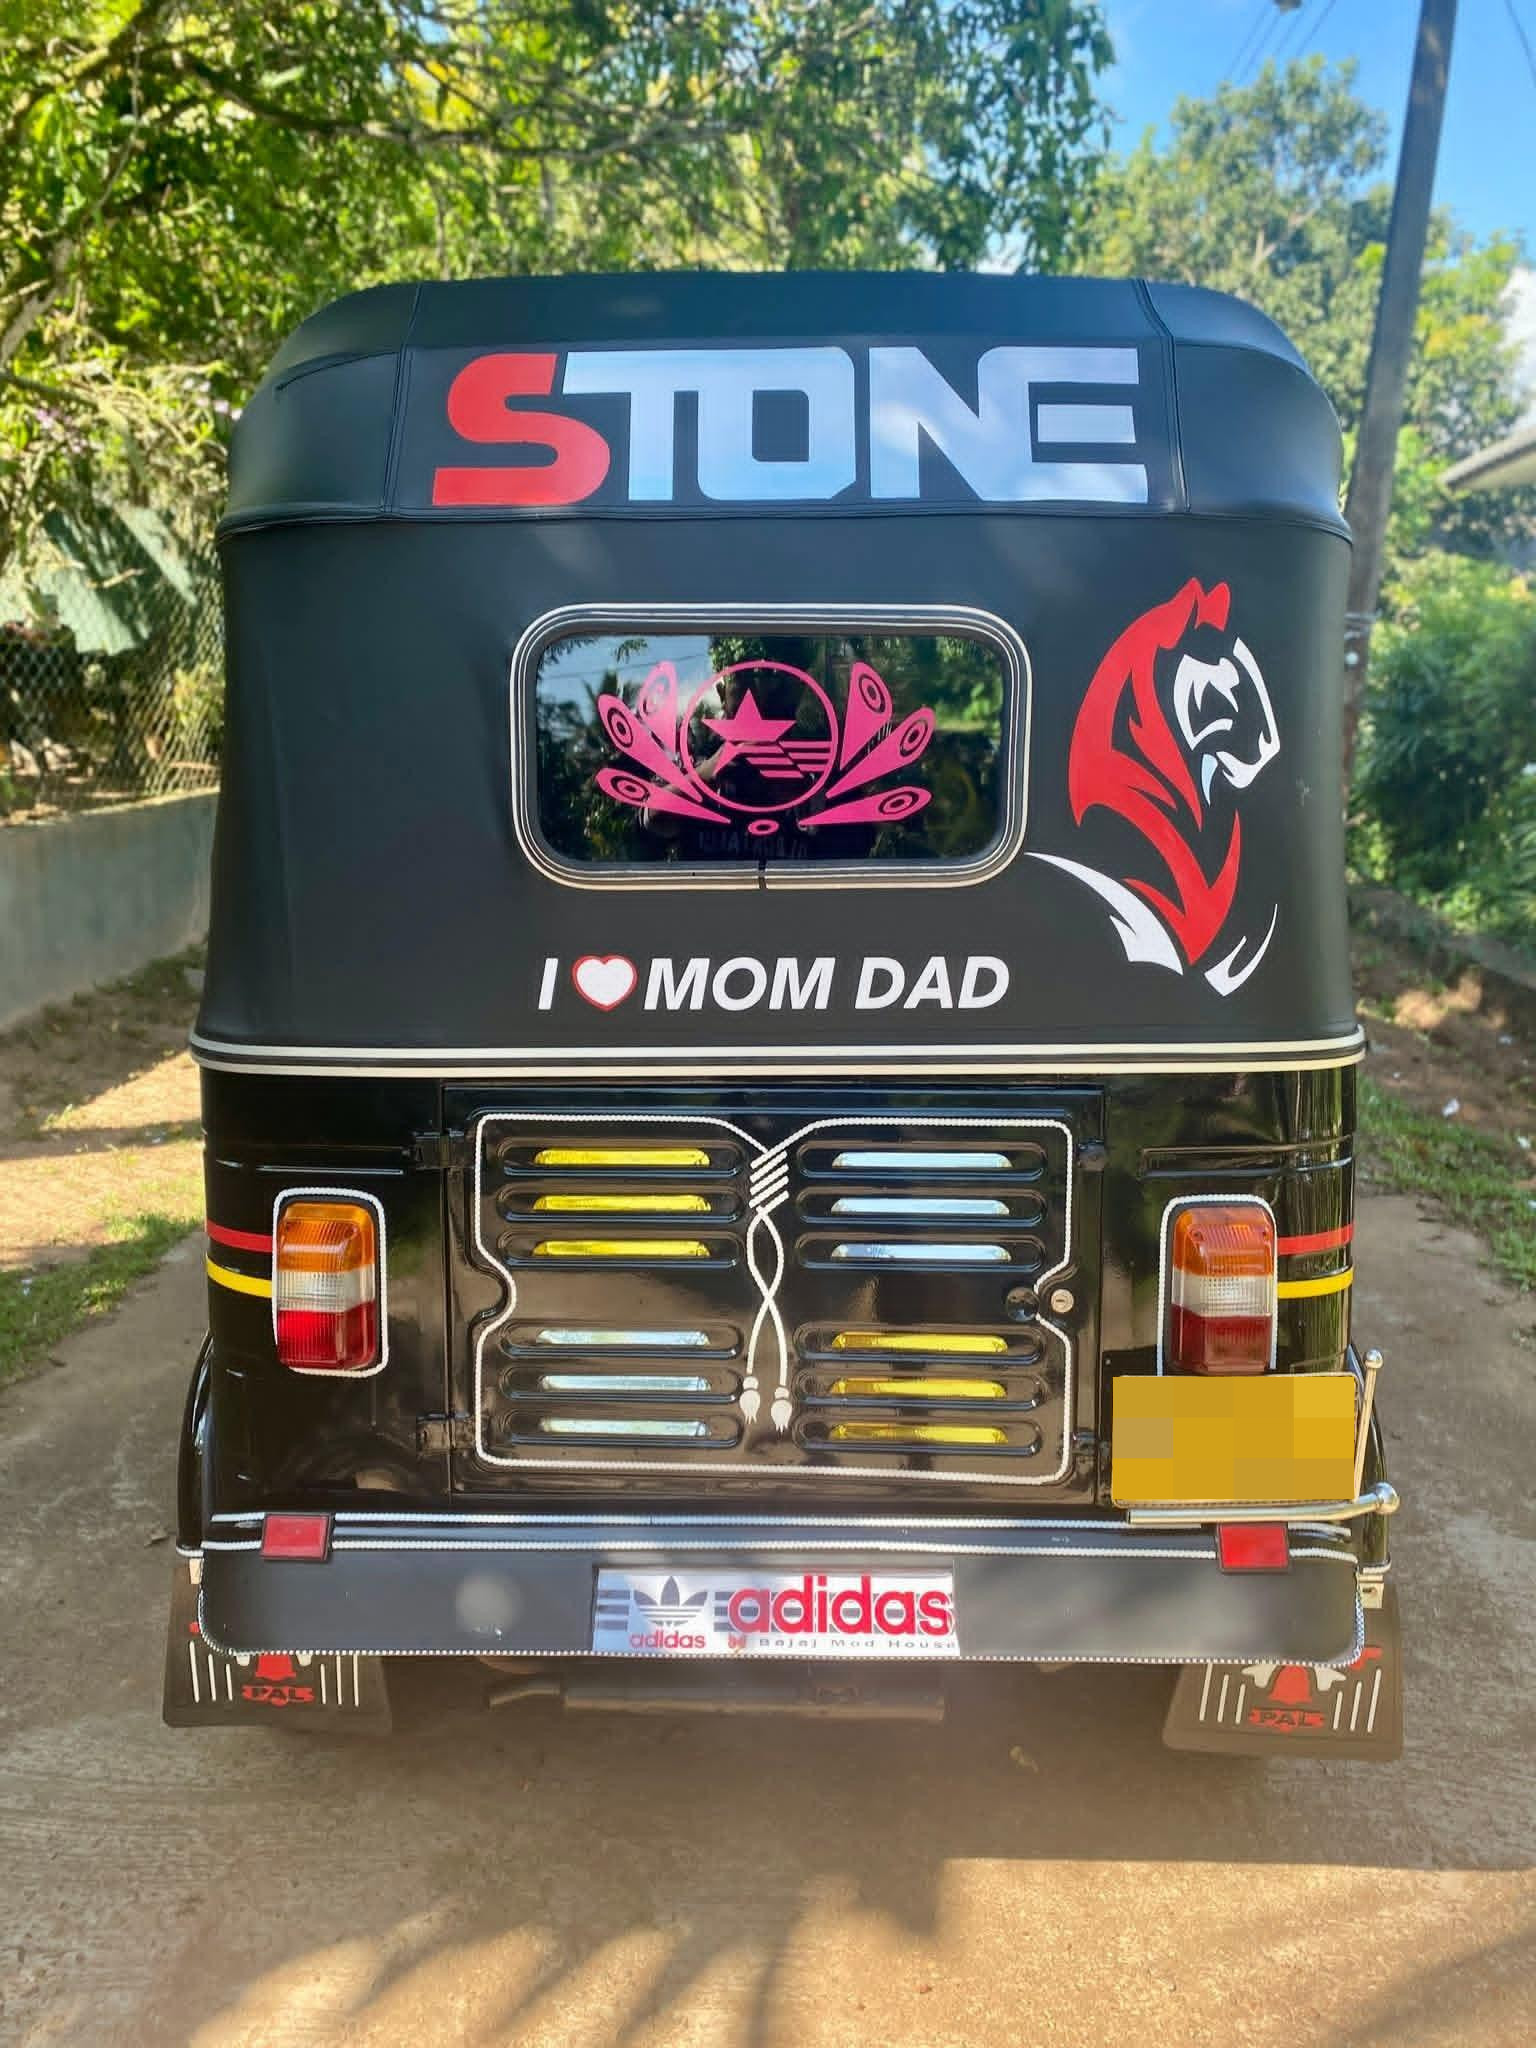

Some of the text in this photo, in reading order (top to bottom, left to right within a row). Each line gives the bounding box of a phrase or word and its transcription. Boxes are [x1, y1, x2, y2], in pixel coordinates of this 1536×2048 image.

[432, 346, 1149, 505] STONE
[538, 956, 1010, 1011] I MOM DAD
[728, 1574, 954, 1635] adidas
[629, 1630, 706, 1650] adidas
[251, 1686, 305, 1701] PAL
[1258, 1710, 1313, 1727] PAL
